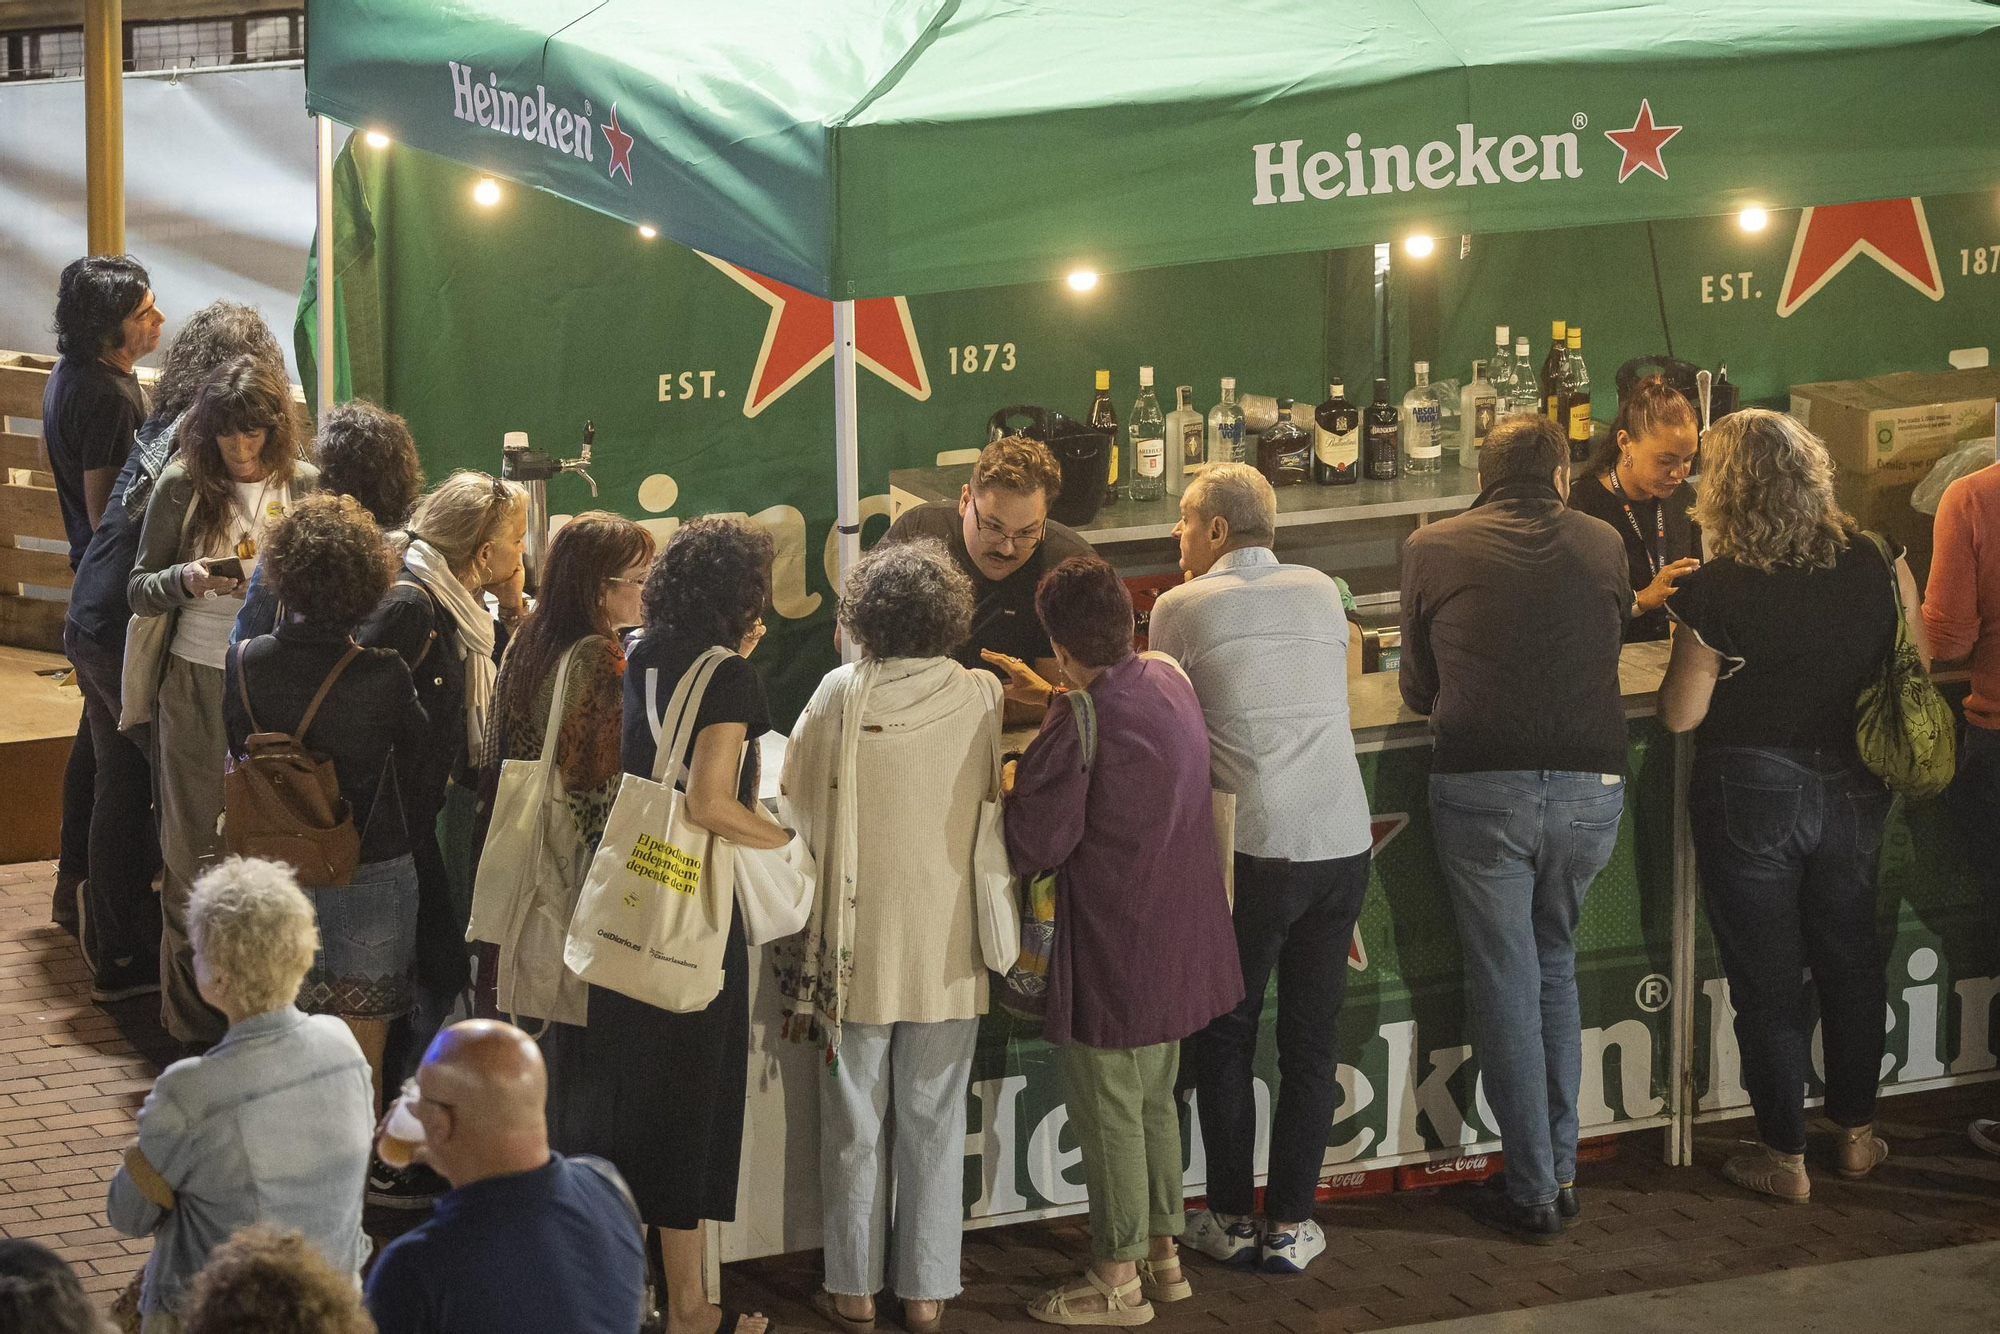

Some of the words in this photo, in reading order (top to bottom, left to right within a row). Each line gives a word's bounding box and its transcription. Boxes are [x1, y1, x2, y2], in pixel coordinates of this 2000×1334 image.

[449, 61, 594, 163] Heineken
[1252, 123, 1584, 206] Heineken
[1701, 271, 1763, 304] EST.
[948, 342, 1017, 375] 1873
[657, 370, 727, 402] EST.
[637, 832, 651, 846] El
[648, 839, 701, 870] peodismo
[670, 877, 683, 891] de
